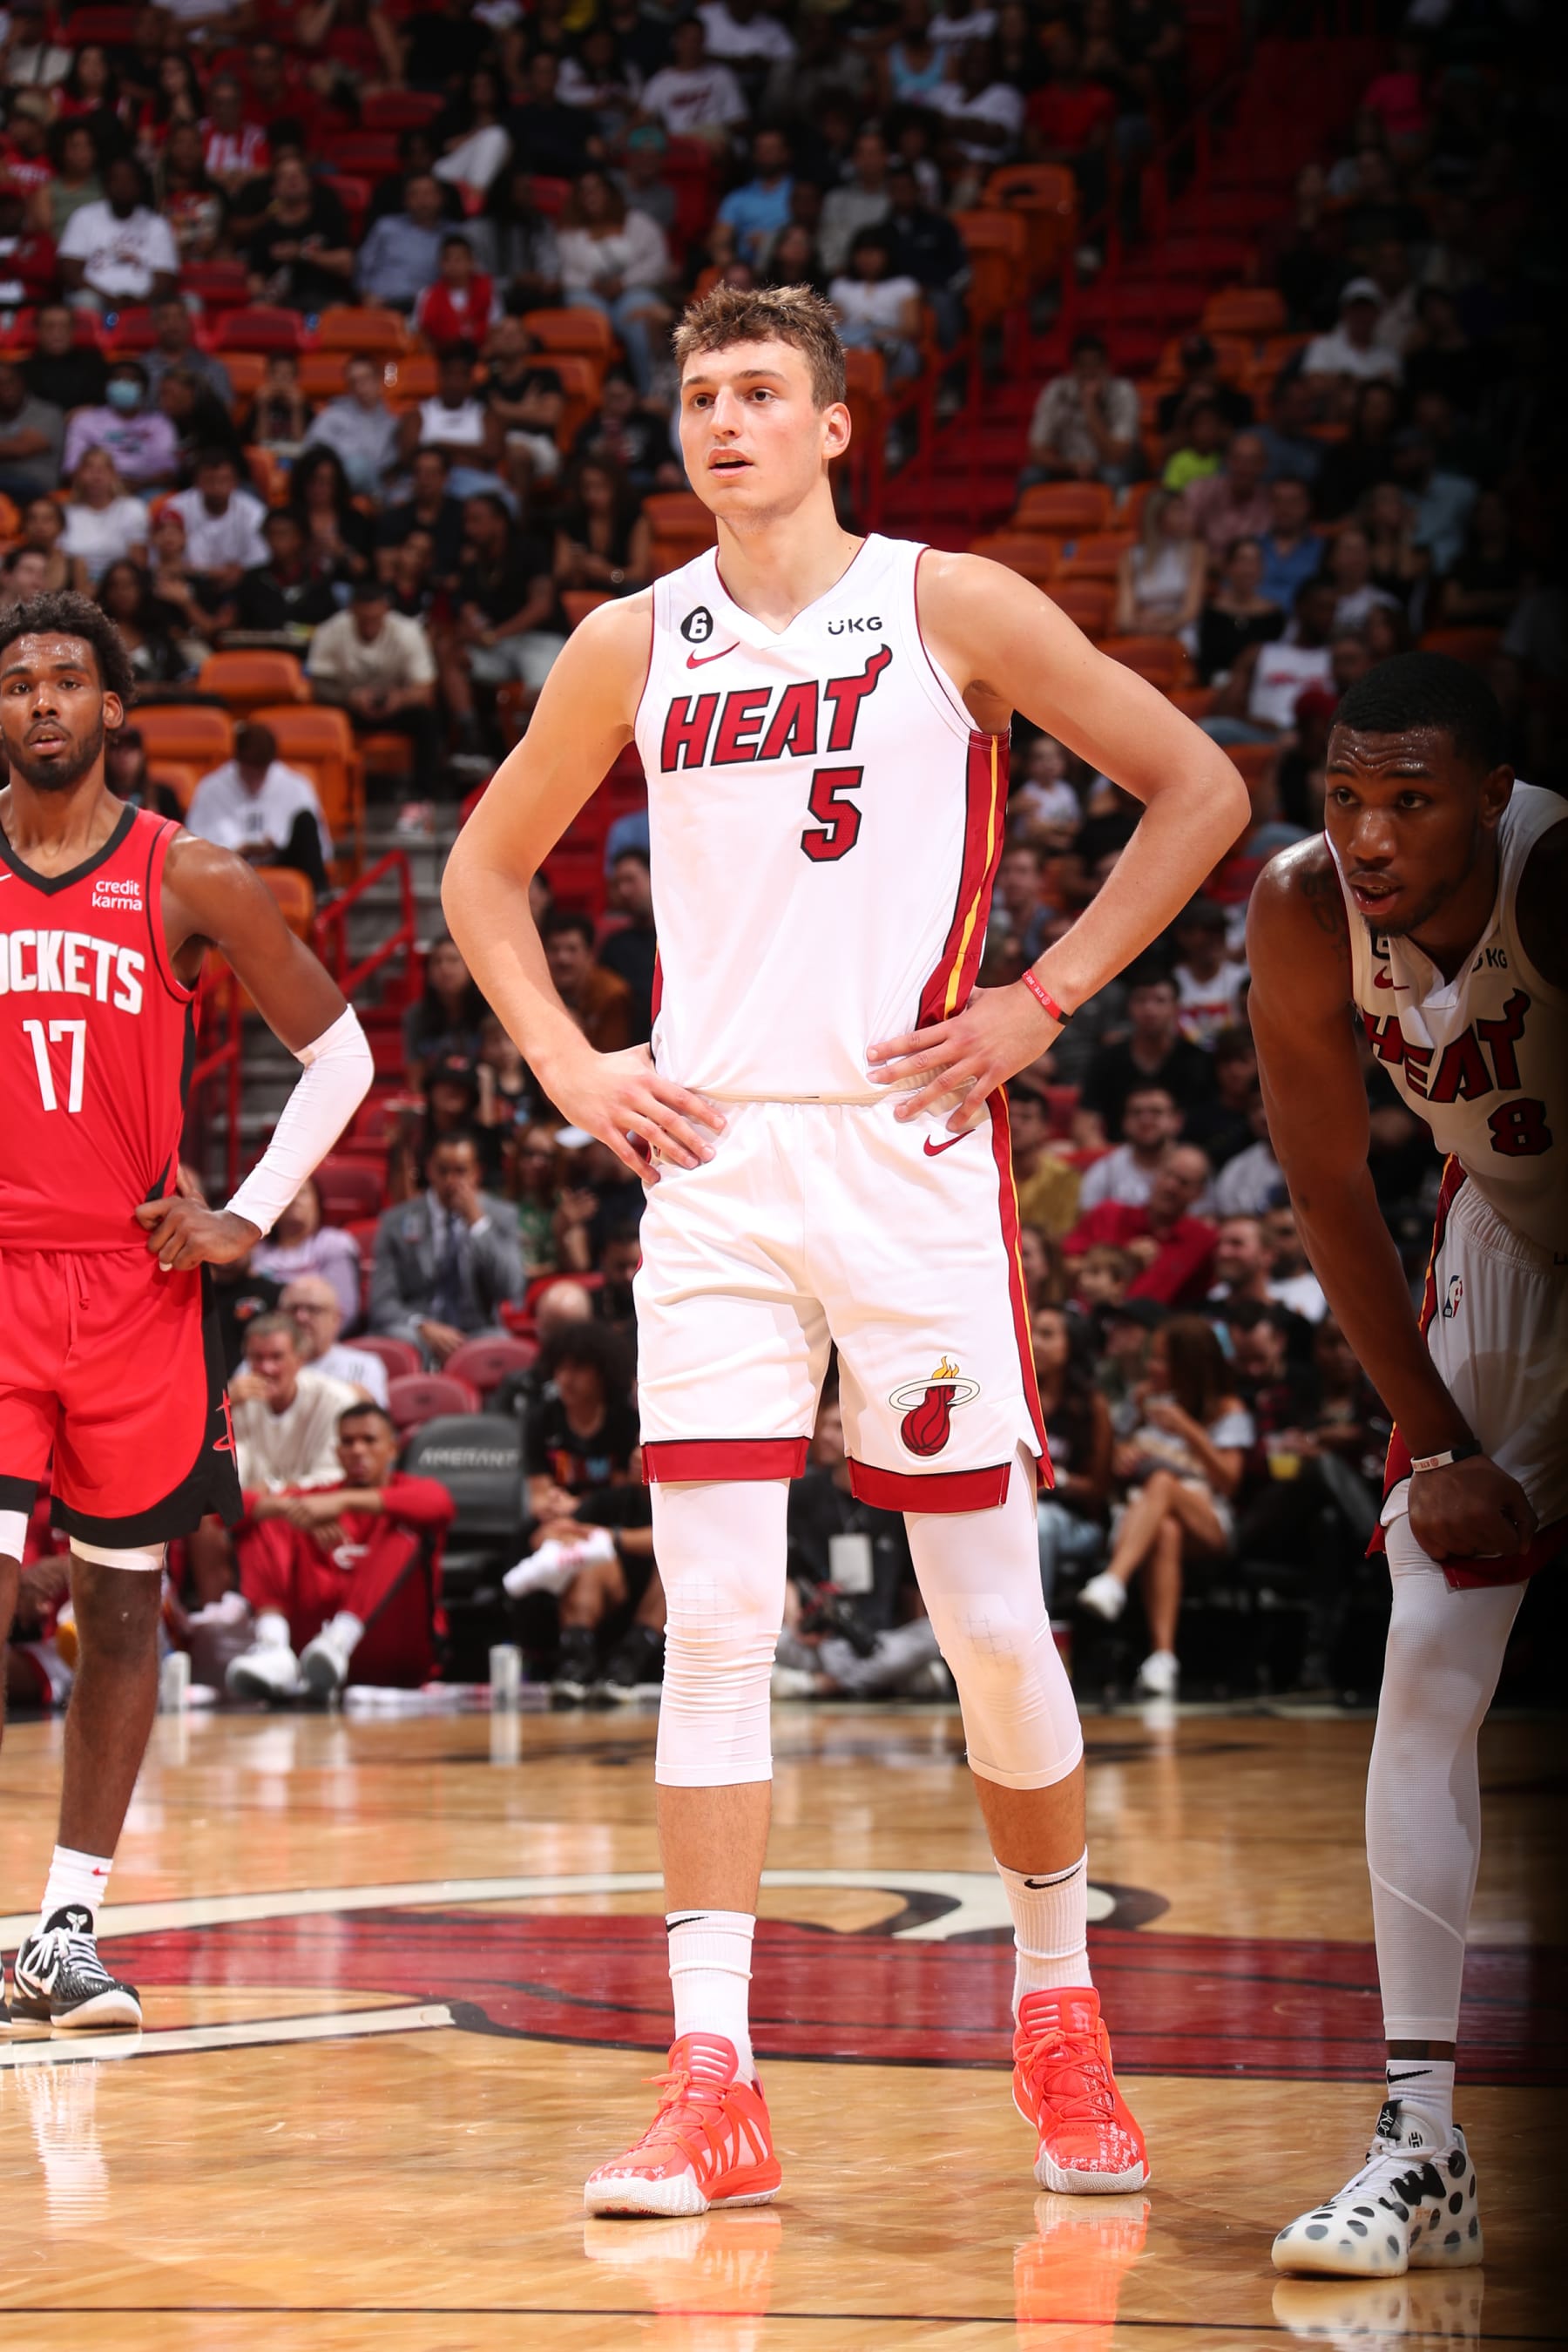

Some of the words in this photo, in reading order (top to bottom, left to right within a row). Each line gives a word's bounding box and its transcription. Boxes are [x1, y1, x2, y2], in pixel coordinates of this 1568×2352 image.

[687, 612, 707, 640] 6
[660, 643, 893, 774] HEAT
[801, 765, 864, 862] 5
[91, 892, 143, 911] karma
[95, 879, 139, 896] credit
[22, 1018, 87, 1113] 17
[1362, 987, 1531, 1104] HEAT
[1487, 1097, 1553, 1157] 8
